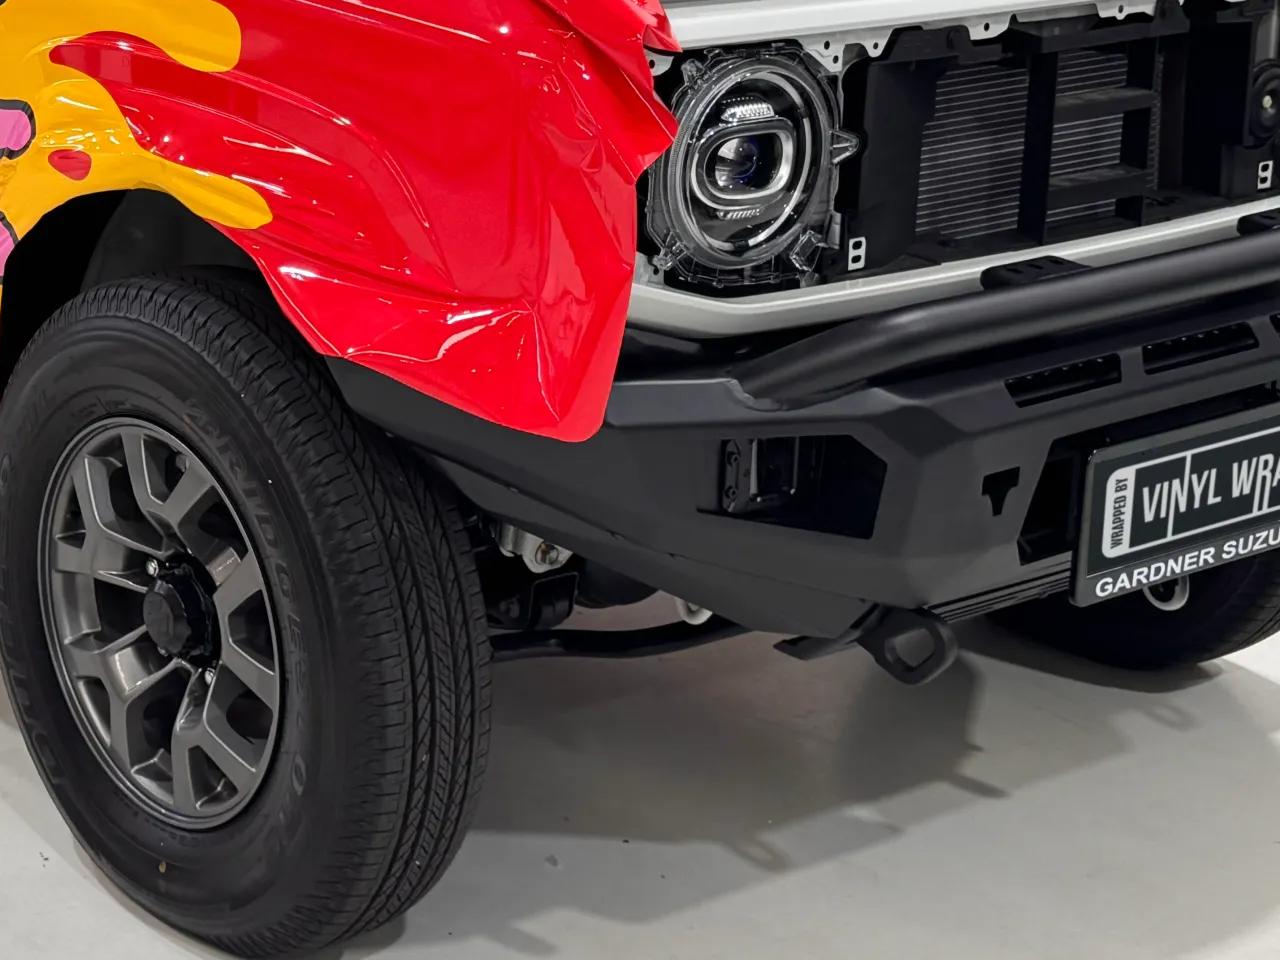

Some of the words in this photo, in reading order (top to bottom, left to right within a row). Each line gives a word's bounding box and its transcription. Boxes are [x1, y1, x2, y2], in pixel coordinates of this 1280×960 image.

[1114, 477, 1129, 493] BY
[1142, 455, 1222, 536] VINYL
[1110, 495, 1128, 549] WRAPPED
[1095, 547, 1216, 597] GARDNER
